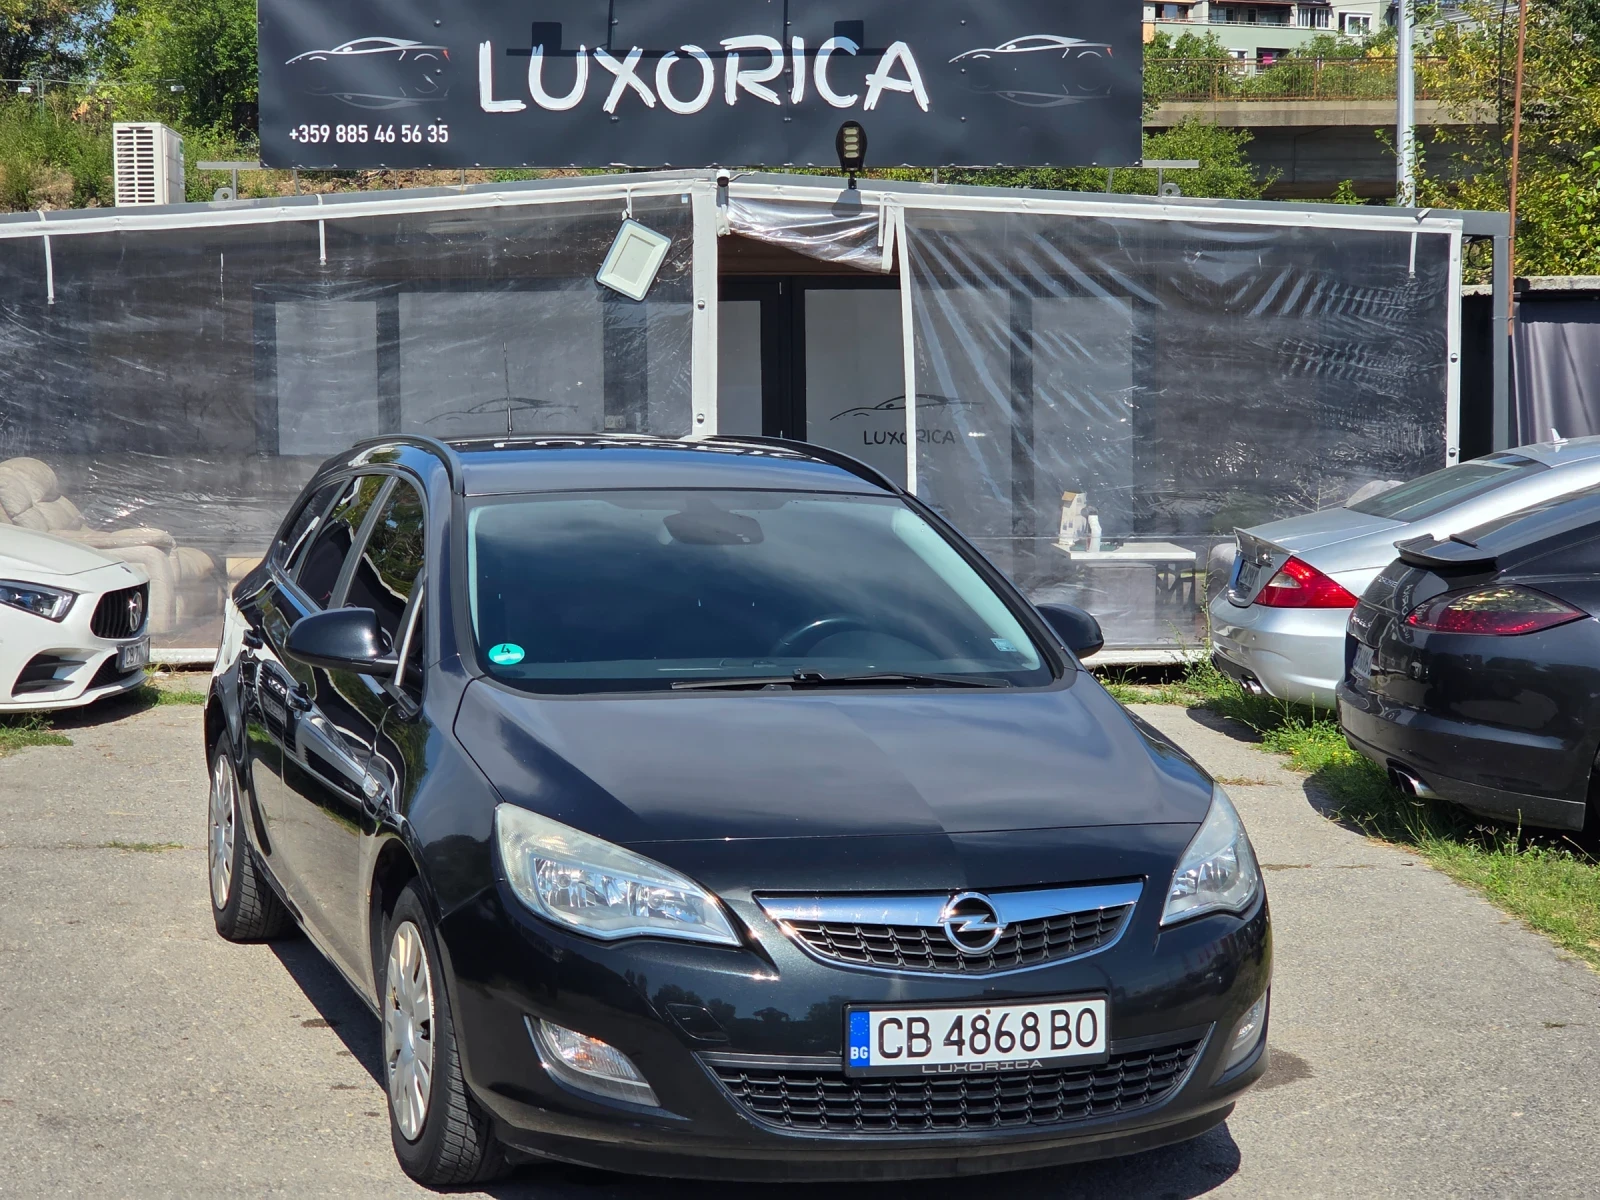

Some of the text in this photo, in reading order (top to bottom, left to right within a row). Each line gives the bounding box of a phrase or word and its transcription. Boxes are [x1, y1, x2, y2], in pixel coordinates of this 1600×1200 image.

[478, 34, 932, 115] LUXORICA
[289, 124, 449, 143] +359 885 46 56 35
[877, 1016, 932, 1060] CB
[942, 1011, 1041, 1057] 4868
[850, 1046, 869, 1060] BG
[921, 1060, 1043, 1074] LUXORICA
